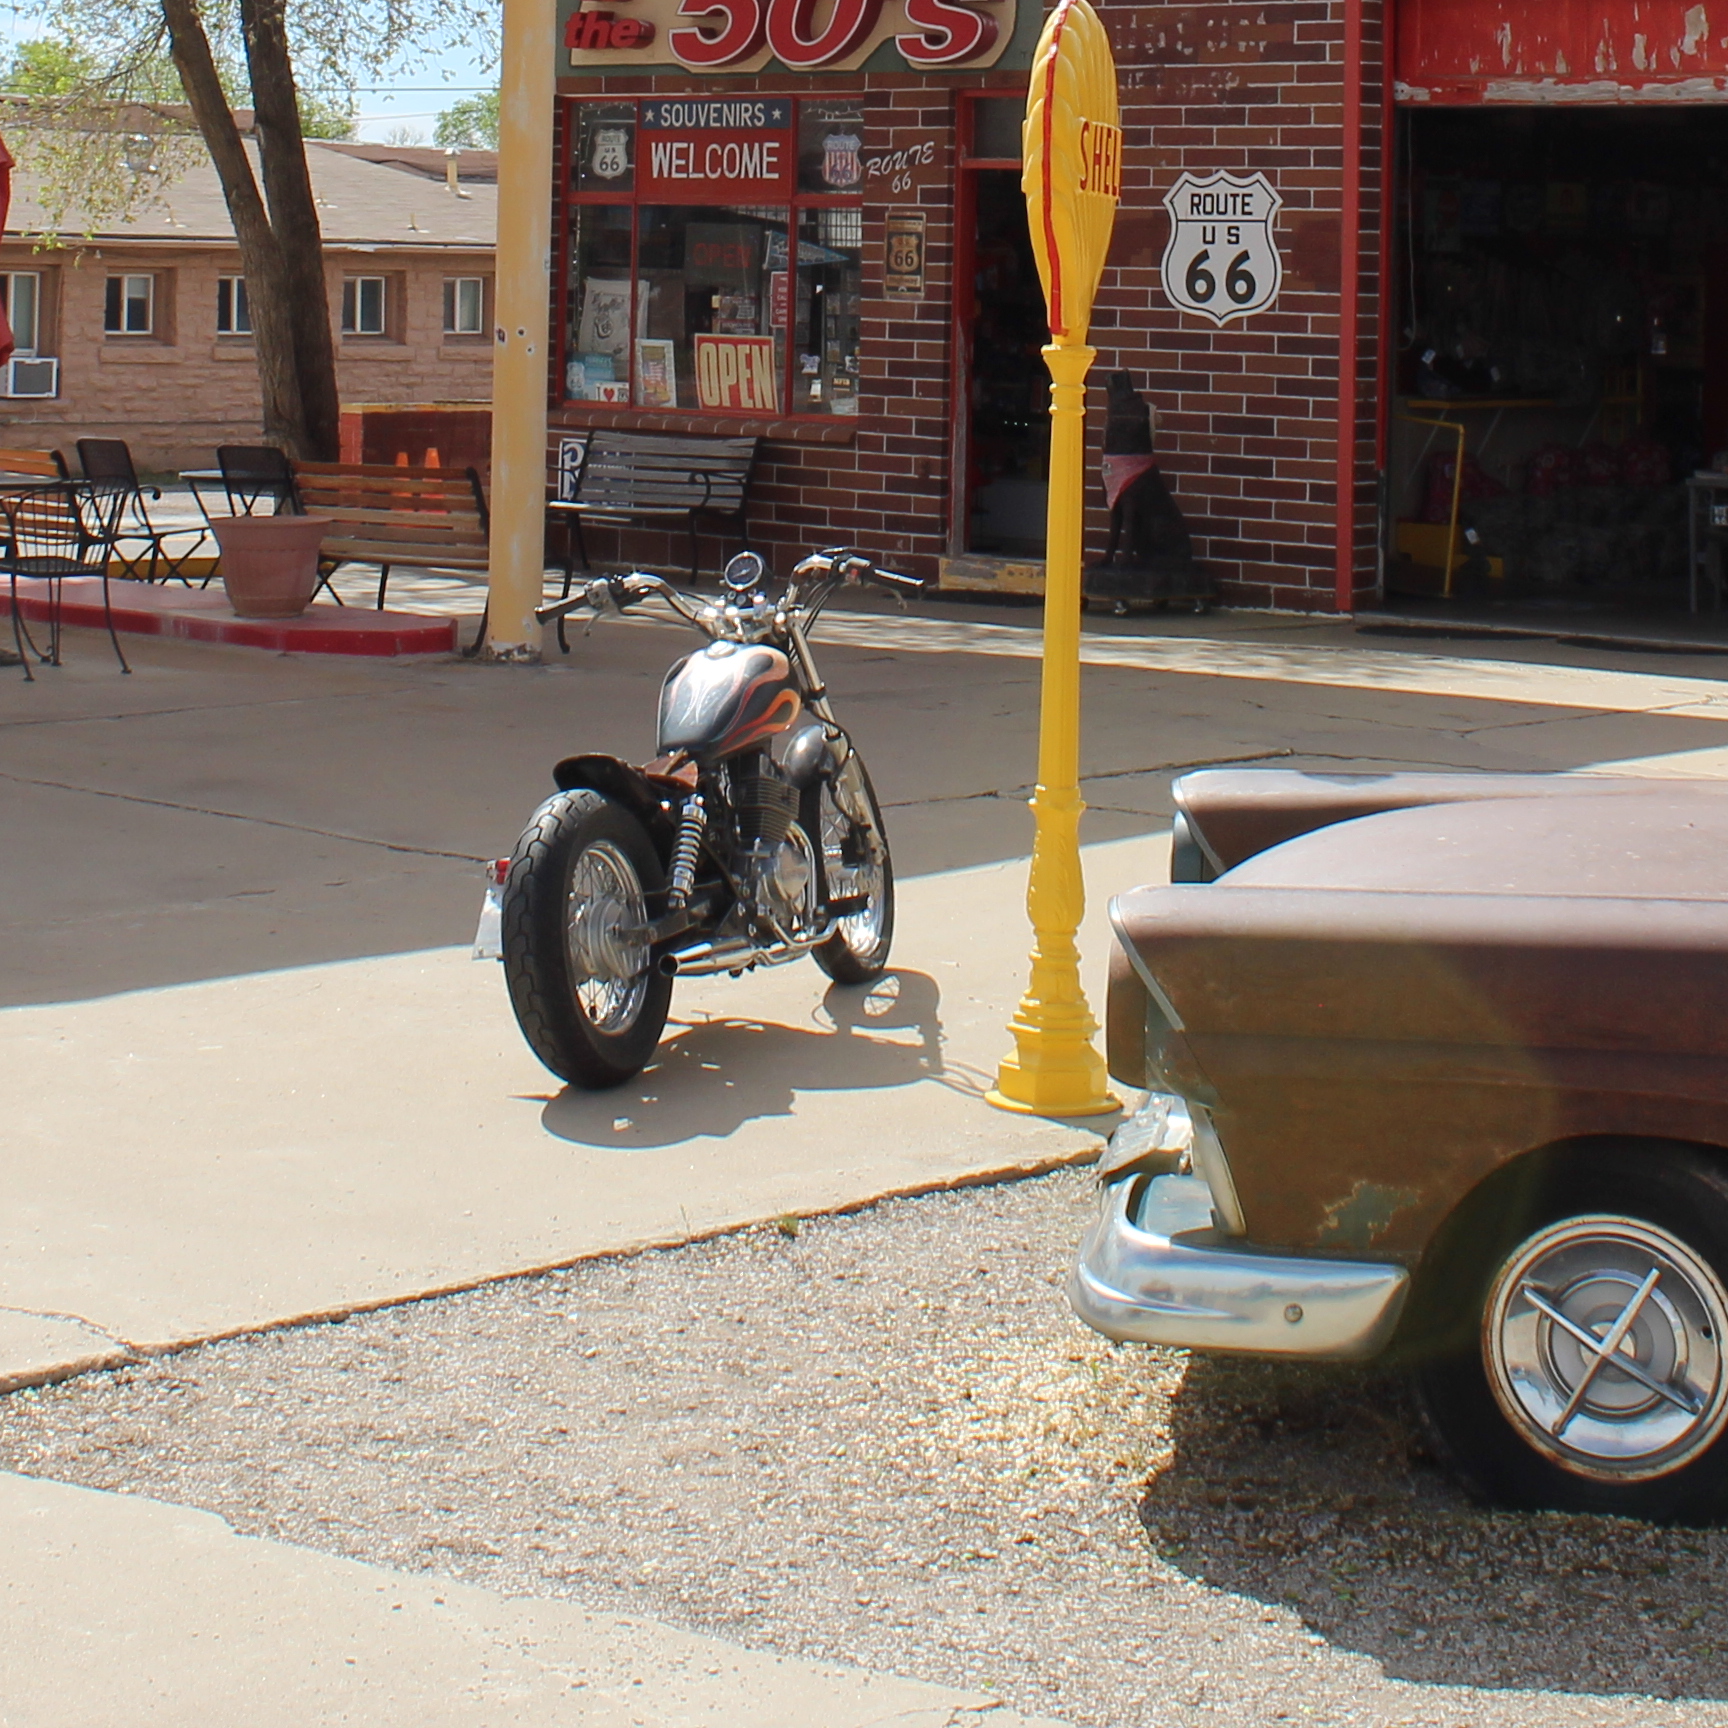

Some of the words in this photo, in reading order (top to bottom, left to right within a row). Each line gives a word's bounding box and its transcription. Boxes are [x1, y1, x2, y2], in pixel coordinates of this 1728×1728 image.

[564, 10, 647, 50] the
[660, 103, 766, 127] SOUVENIRS
[827, 140, 855, 151] ROUTE
[599, 155, 620, 172] 66
[650, 141, 780, 180] WELCOME
[866, 141, 935, 180] ROUTE
[1080, 121, 1122, 197] SHEL
[892, 171, 912, 194] 66
[1190, 193, 1254, 216] ROUTE
[692, 243, 752, 268] OPEN
[894, 250, 914, 268] 66
[1185, 248, 1257, 304] 66
[700, 342, 774, 409] OPEN
